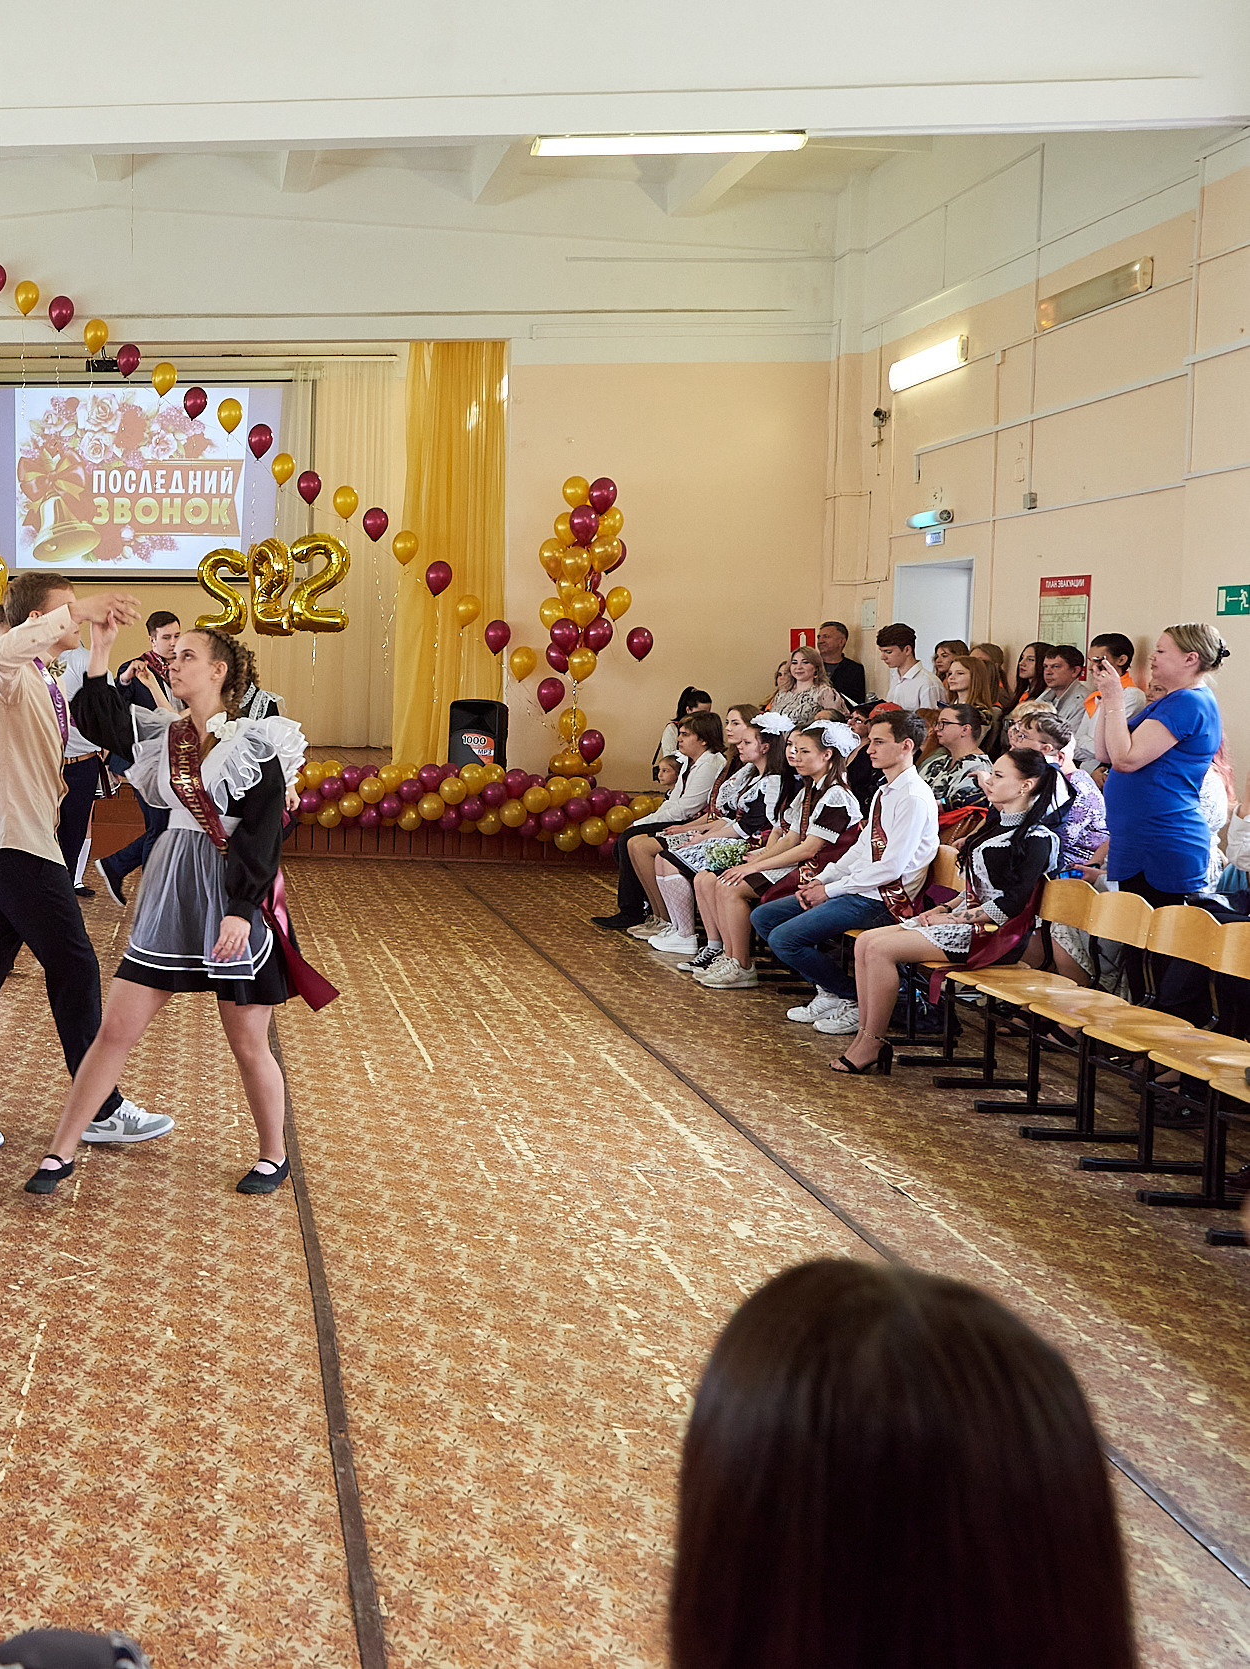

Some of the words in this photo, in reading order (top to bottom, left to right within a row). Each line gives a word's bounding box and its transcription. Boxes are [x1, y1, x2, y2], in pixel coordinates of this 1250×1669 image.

[92, 467, 233, 494] ПОСЛЕДНИЙ
[92, 496, 231, 525] ЗВОНОК
[462, 735, 487, 746] 1000
